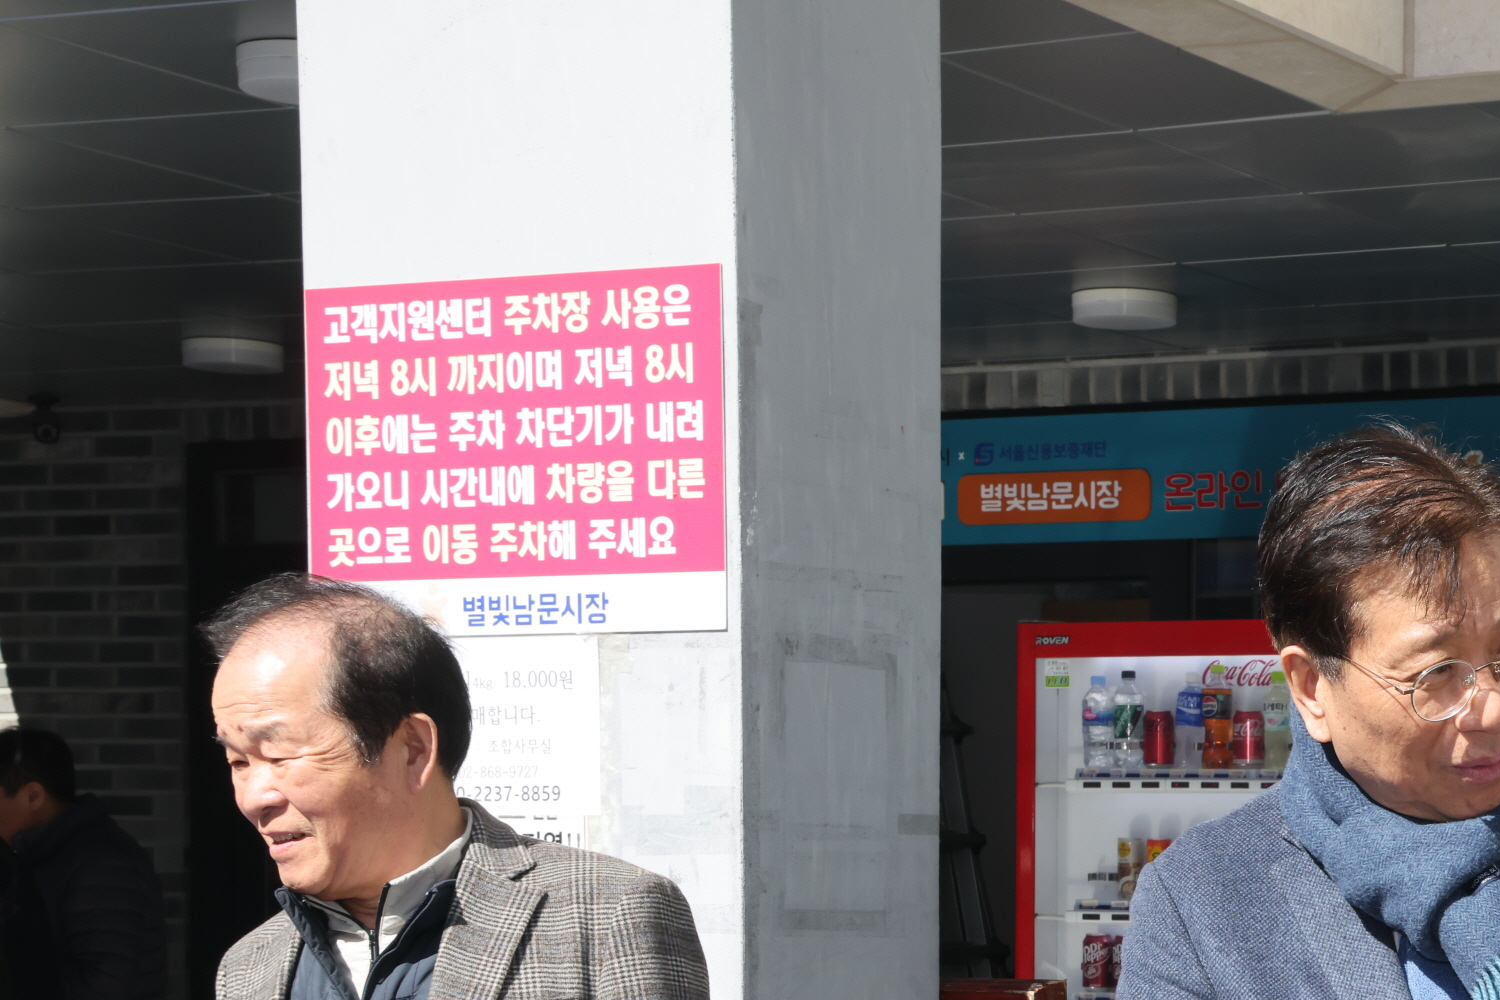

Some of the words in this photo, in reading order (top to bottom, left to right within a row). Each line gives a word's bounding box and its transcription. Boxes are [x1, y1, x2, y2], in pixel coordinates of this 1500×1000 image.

[323, 296, 492, 344] 고객지원센터
[504, 290, 591, 336] 주차장
[601, 283, 692, 330] 사용은
[324, 358, 379, 401] 저녁
[390, 356, 436, 397] 8시
[447, 349, 562, 395] 까지이며
[574, 345, 633, 388] 저녁
[645, 342, 694, 383] 8시
[326, 412, 437, 456] 이후에는
[448, 409, 505, 452] 주차
[515, 403, 634, 448] 차단기가
[646, 400, 704, 442] 내려
[999, 441, 1107, 462] 서울신용보증재단
[326, 469, 409, 513] 가오니
[421, 464, 535, 508] 시간내에
[546, 460, 634, 504] 차량을
[647, 457, 706, 500] 다른
[980, 480, 1122, 512] 별빛남문시장
[1164, 469, 1262, 511] 온라인
[328, 526, 411, 567] 곳으로
[422, 523, 478, 564] 이동
[490, 518, 576, 563] 주차해
[588, 516, 676, 559] 주세요
[463, 591, 609, 627] 별빛남문시장
[1035, 636, 1070, 645] ROVEN
[504, 670, 573, 690] 18,000원
[1202, 659, 1278, 688] Cca-Cola
[488, 738, 551, 755] 조합사무실
